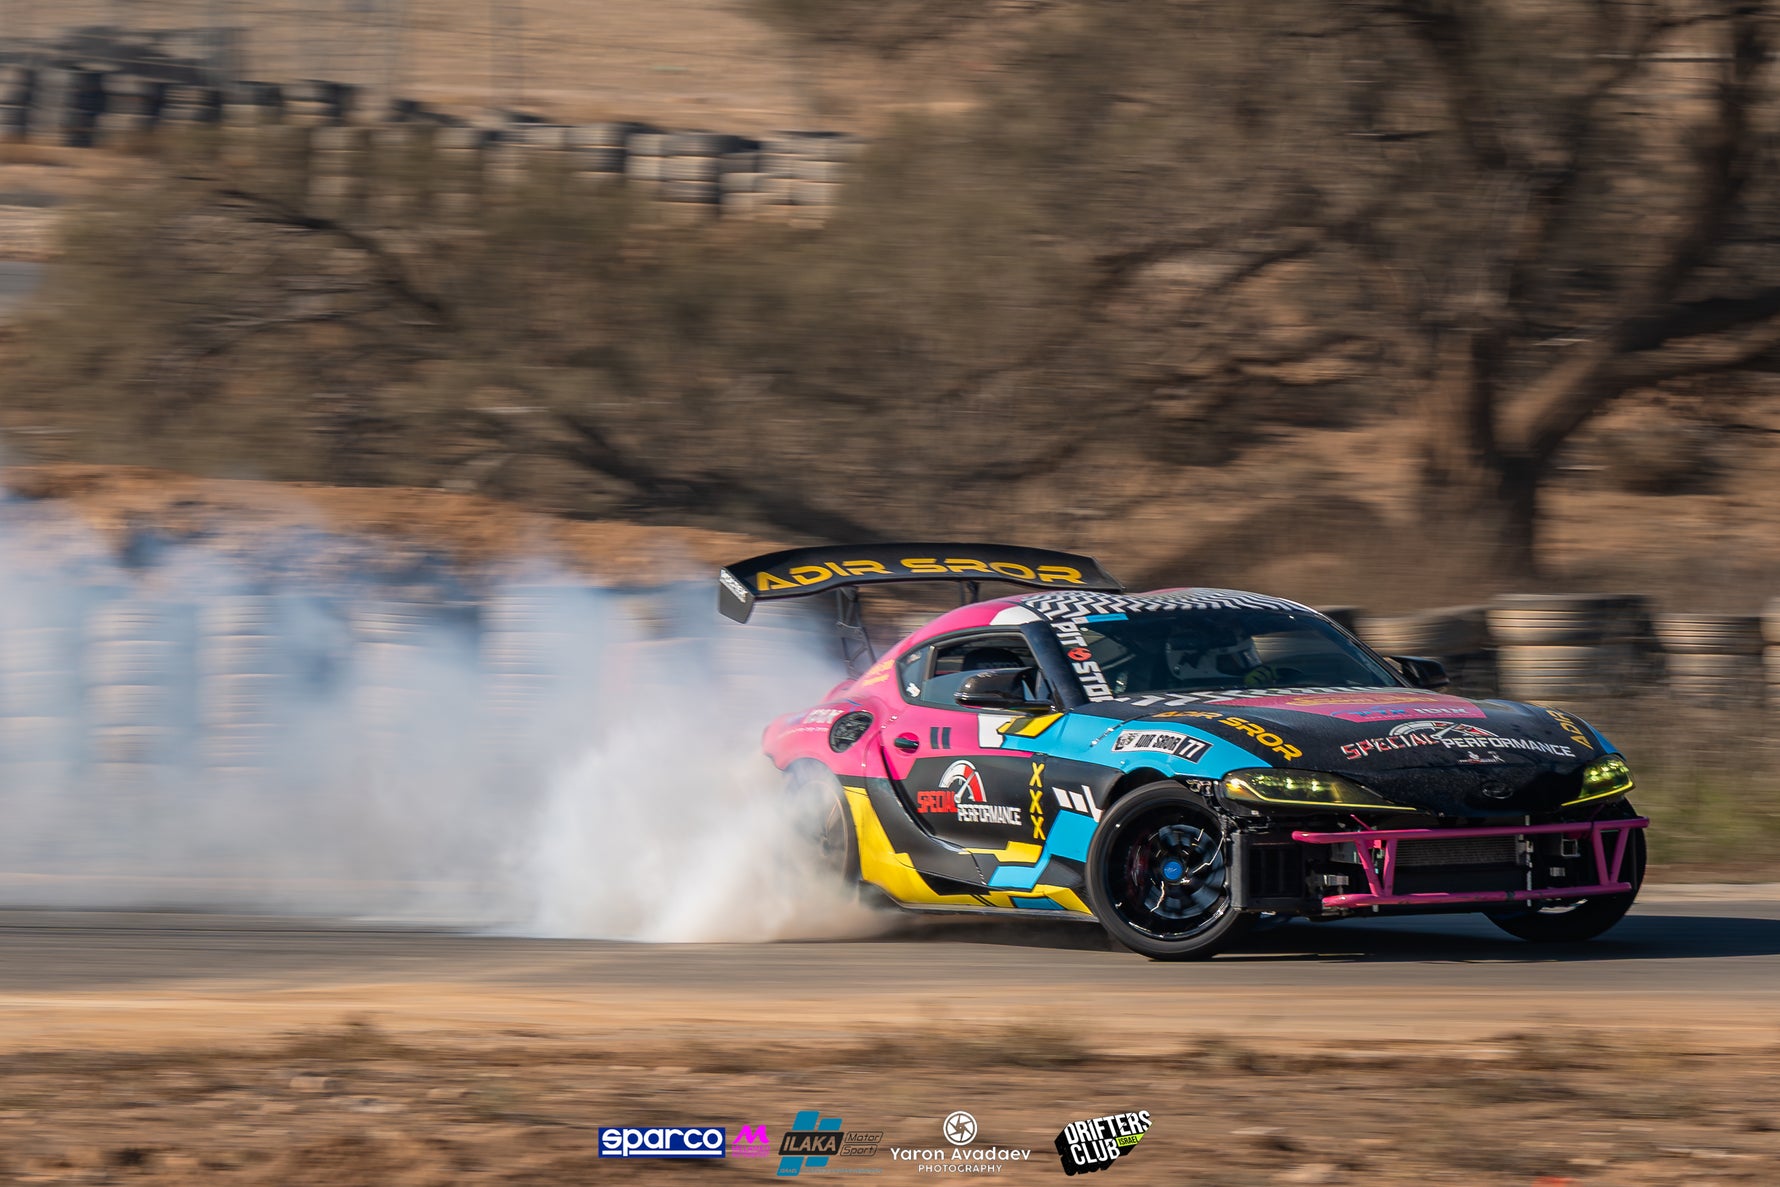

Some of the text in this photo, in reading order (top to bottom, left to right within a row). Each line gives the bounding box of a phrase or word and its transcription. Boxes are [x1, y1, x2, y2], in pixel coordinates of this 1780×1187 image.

[756, 559, 893, 591] ADIR
[900, 558, 1087, 585] SROR
[1050, 620, 1088, 647] PIT
[1179, 739, 1206, 758] 77
[1218, 716, 1303, 761] SROR
[1340, 731, 1576, 760] SPECIAL PERFORMANCE
[957, 804, 1022, 825] PERFORMANCE
